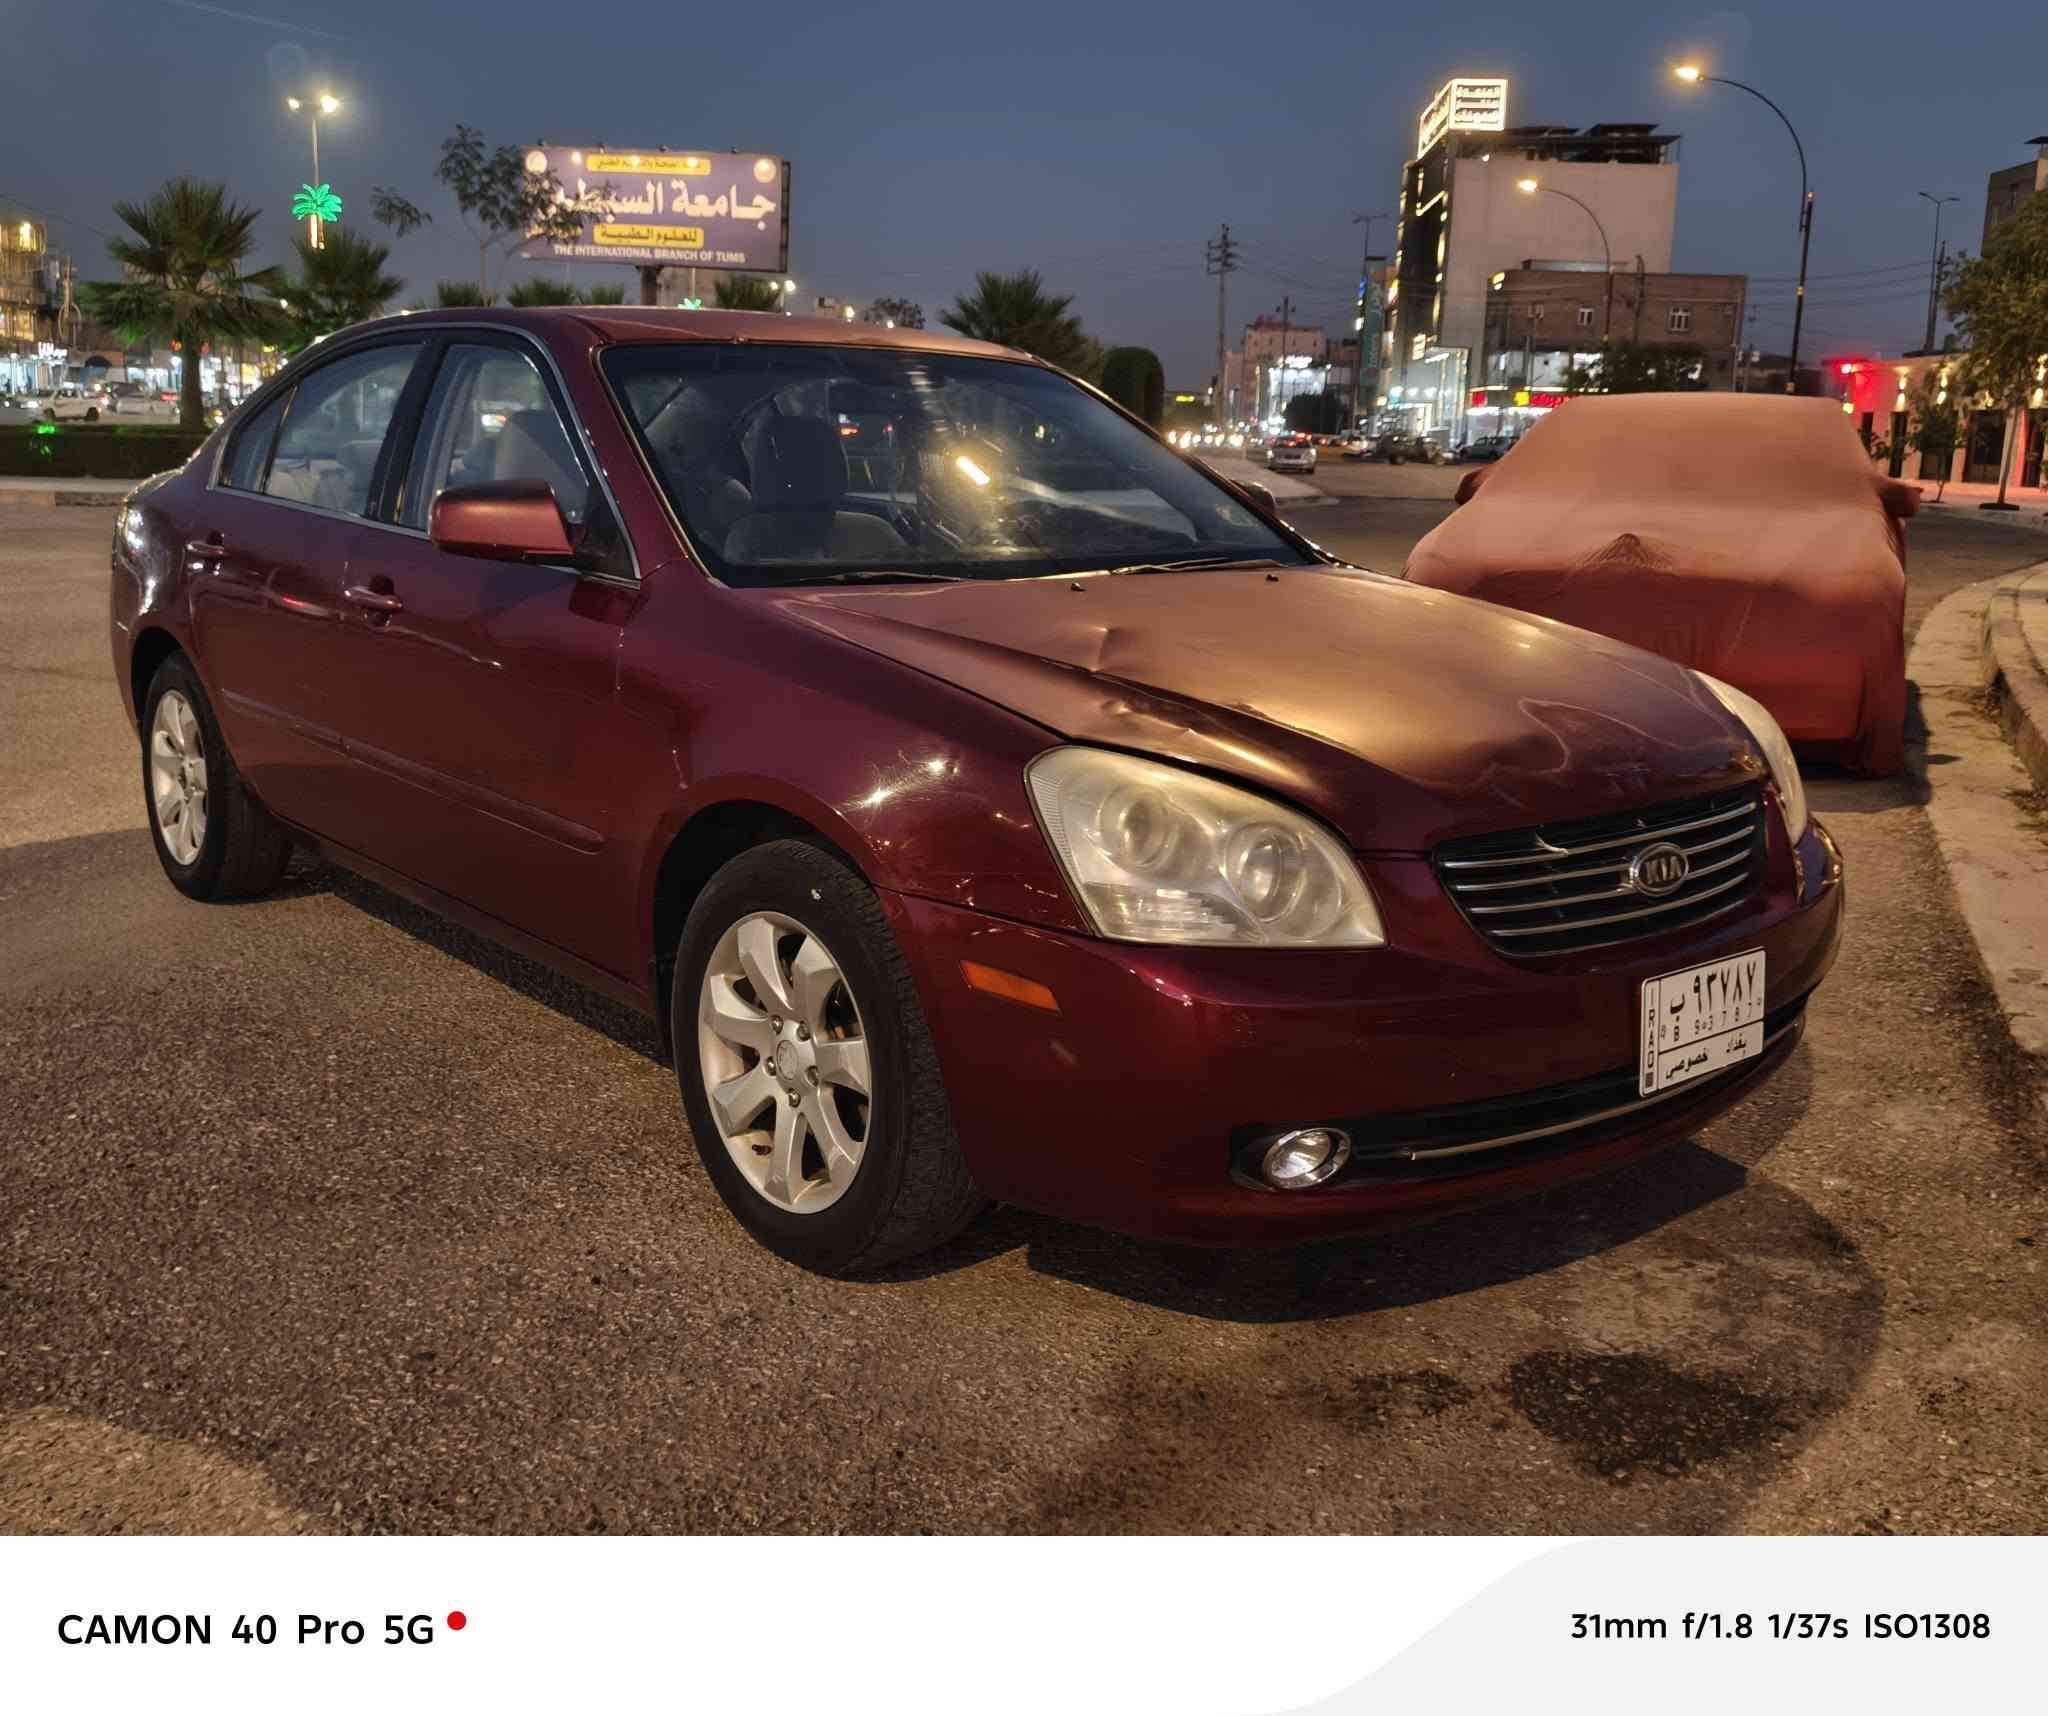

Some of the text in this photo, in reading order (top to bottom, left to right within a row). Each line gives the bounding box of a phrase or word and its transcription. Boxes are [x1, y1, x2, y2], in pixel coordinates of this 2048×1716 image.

[671, 178, 776, 230] جامعة
[554, 245, 573, 256] THE
[575, 245, 652, 258] INTERNATIONAL
[655, 248, 697, 260] BRANCH
[699, 250, 714, 262] OF
[1646, 855, 1682, 884] KIA
